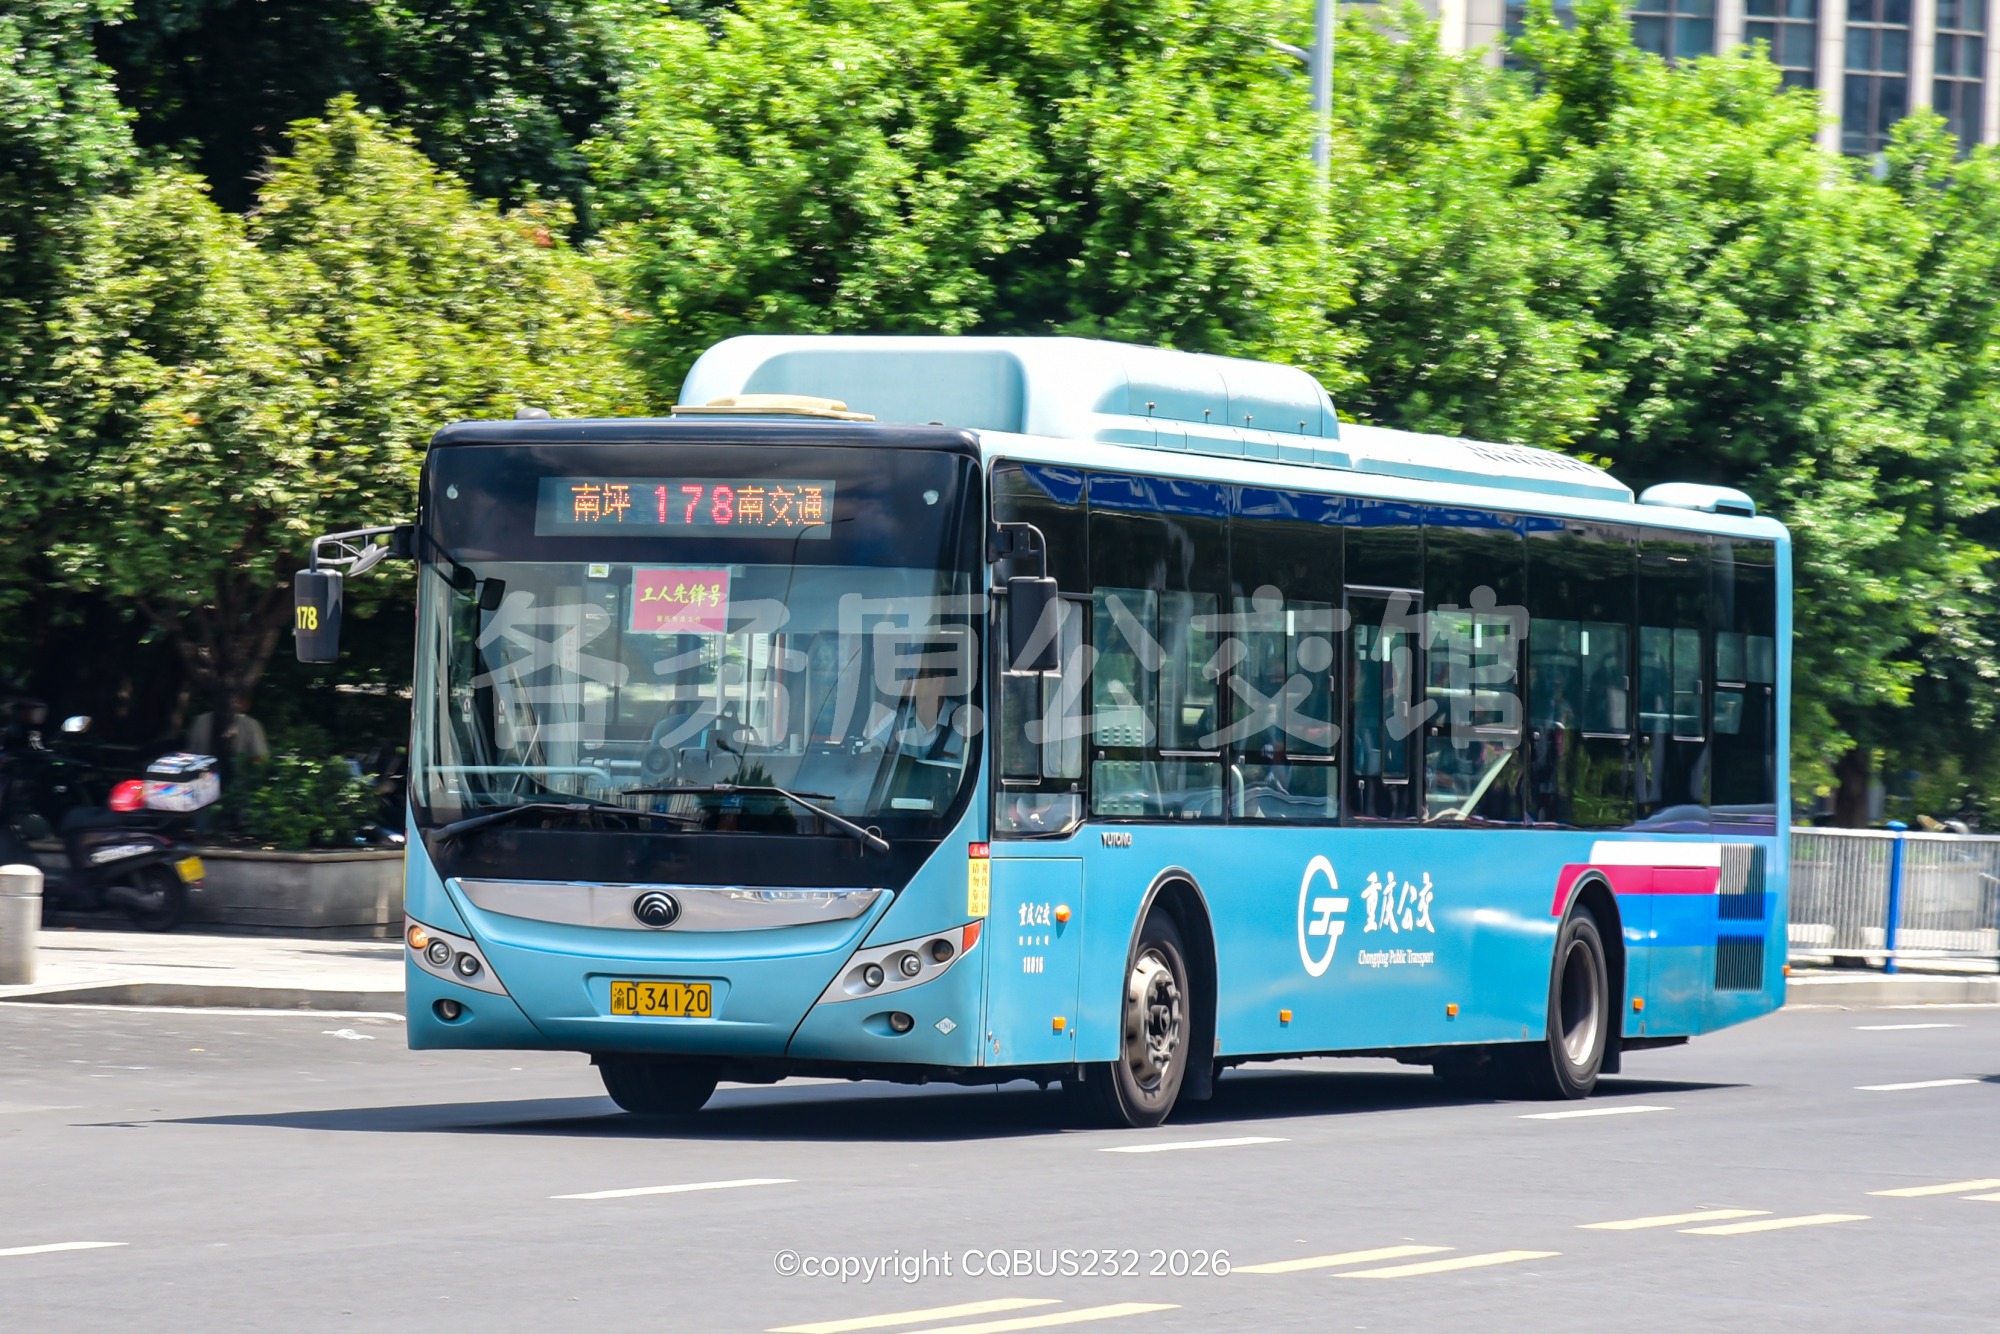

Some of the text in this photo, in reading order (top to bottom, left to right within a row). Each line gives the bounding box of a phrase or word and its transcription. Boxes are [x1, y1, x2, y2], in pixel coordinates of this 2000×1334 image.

[571, 483, 826, 526] 南坪 178 南交通
[296, 606, 318, 630] 178
[1361, 871, 1435, 934] 重庆公交
